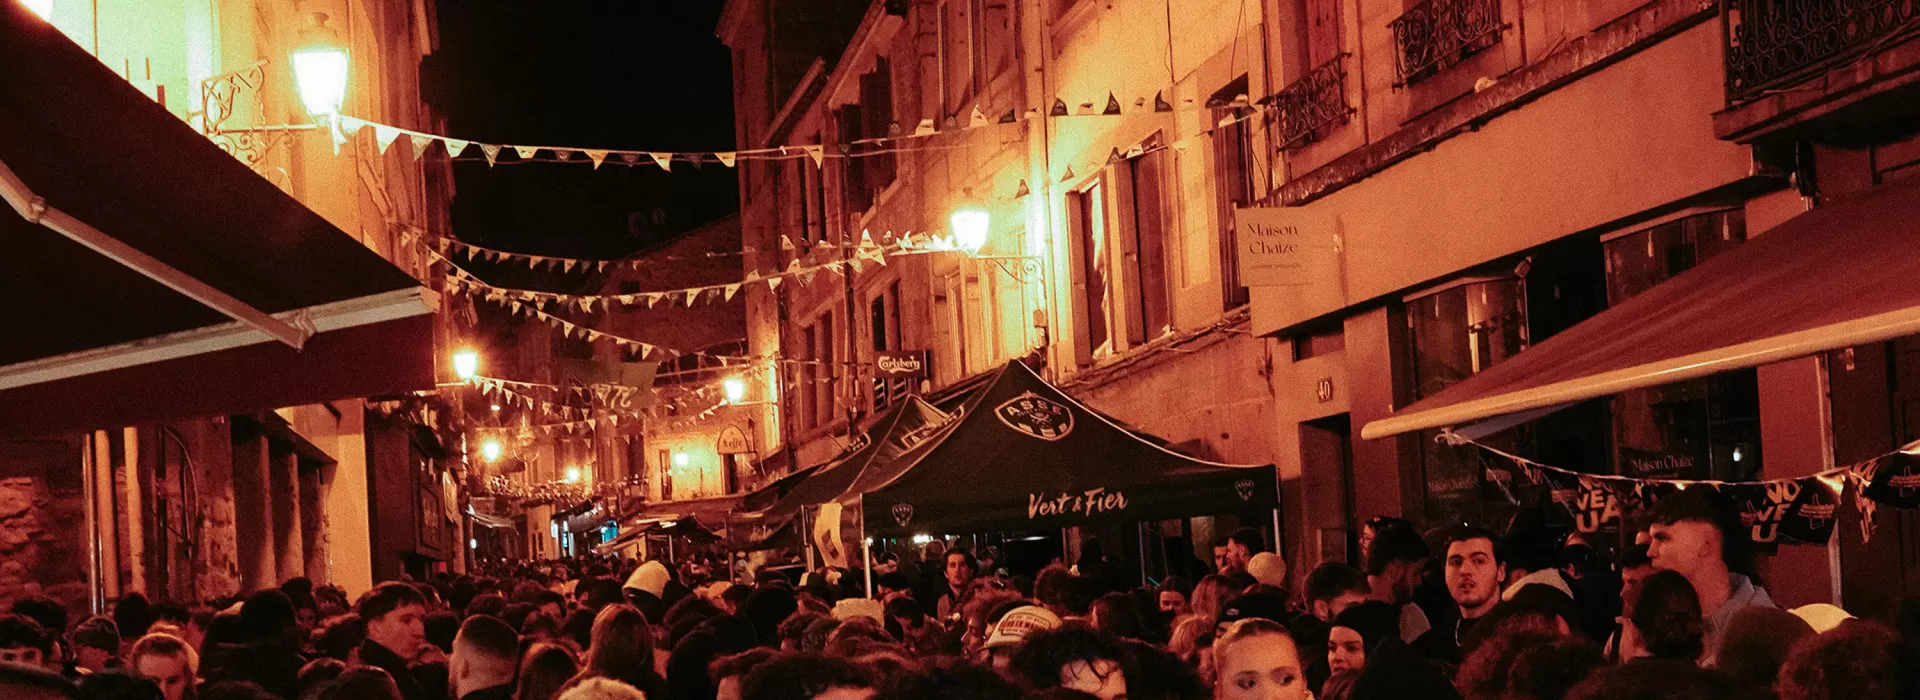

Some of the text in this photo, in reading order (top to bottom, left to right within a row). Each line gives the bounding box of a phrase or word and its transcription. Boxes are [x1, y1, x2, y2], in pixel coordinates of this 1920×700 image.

[1247, 223, 1299, 237] Maison
[1249, 240, 1298, 255] Chaize
[878, 355, 920, 374] Carlsberg
[1318, 380, 1331, 399] 40
[1028, 487, 1128, 519] Vert & Fier
